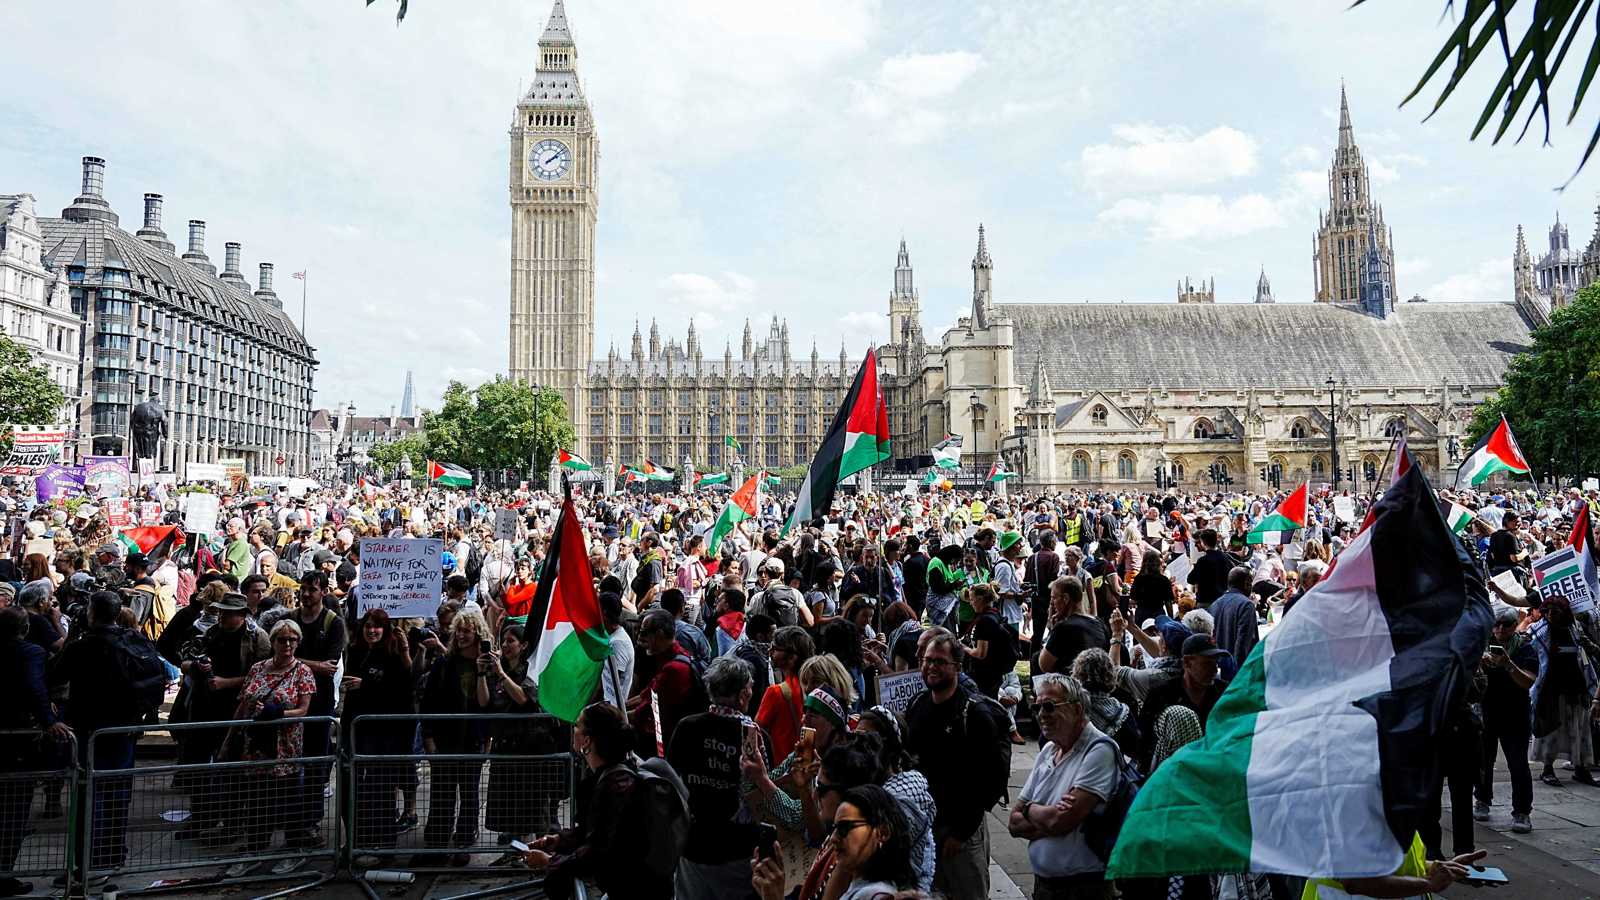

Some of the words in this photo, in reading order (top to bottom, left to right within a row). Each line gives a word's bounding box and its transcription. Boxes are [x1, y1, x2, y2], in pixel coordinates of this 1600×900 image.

[365, 542, 411, 554] STARMER
[424, 544, 437, 556] IS
[363, 557, 403, 570] WAITING
[407, 558, 428, 570] FOR
[362, 572, 382, 581] GAZA
[388, 572, 400, 582] TO
[401, 572, 413, 581] BE
[413, 570, 439, 582] EMPTY
[361, 582, 373, 591] SO
[402, 582, 415, 591] SAY
[1539, 572, 1586, 601] FREE
[1567, 588, 1588, 601] TINE
[884, 678, 903, 688] SHAME
[890, 682, 923, 700] LABOUR
[883, 698, 909, 712] GOVER
[703, 738, 737, 759] stop
[708, 756, 730, 772] the
